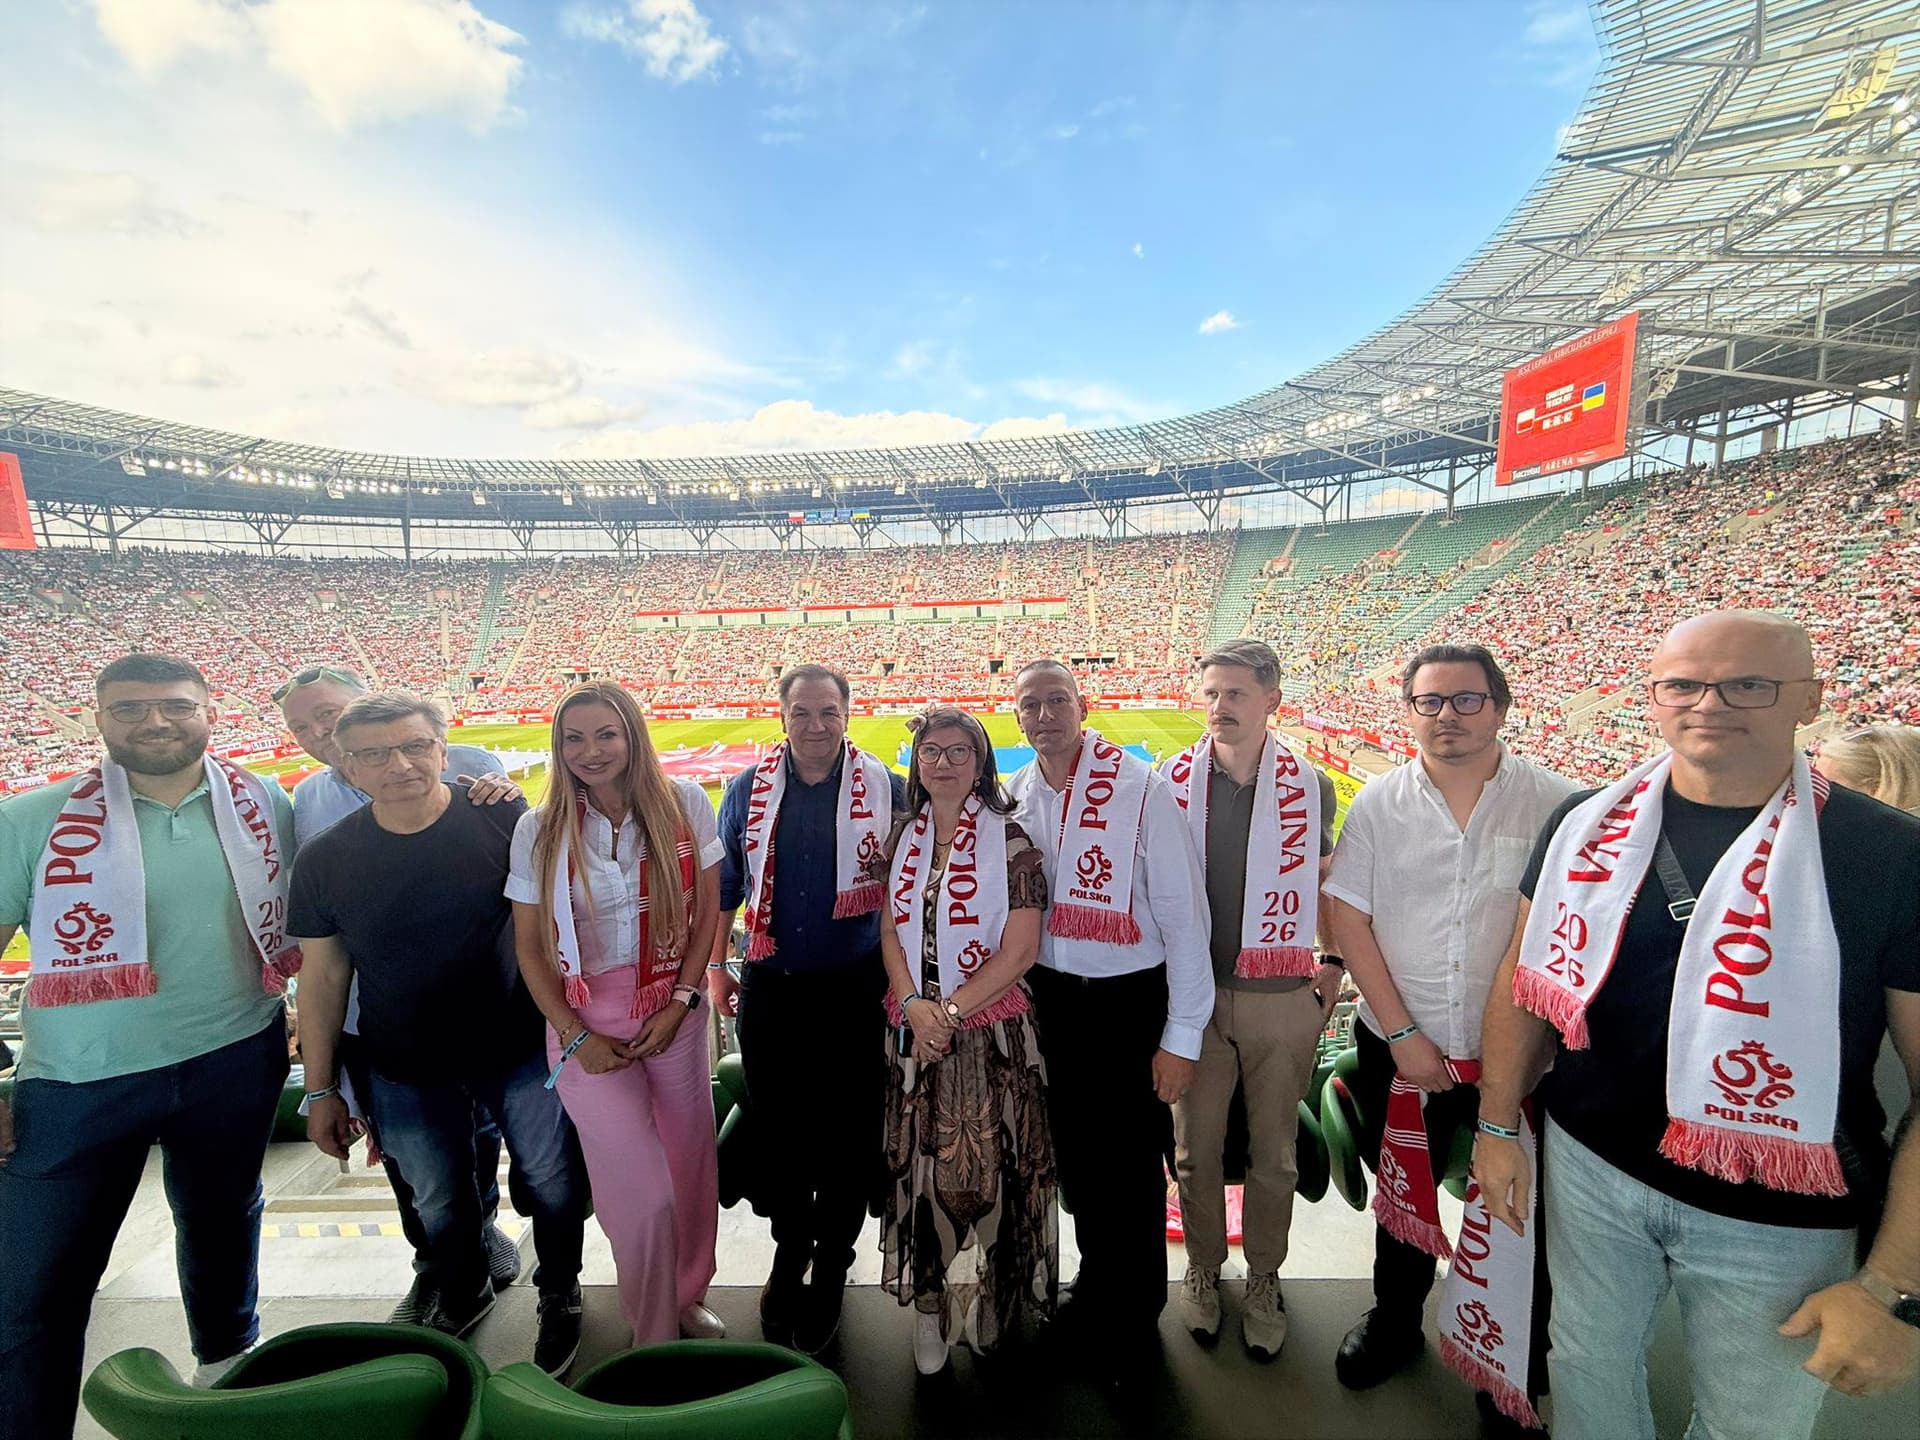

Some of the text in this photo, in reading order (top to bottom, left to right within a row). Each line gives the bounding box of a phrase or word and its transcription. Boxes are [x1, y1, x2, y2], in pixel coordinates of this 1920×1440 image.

[1545, 456, 1574, 471] ARENA
[1069, 887, 1112, 905] POLSKA
[1262, 889, 1300, 917] 20
[258, 895, 284, 928] 20
[1259, 920, 1297, 943] 26
[1552, 901, 1588, 952] 20
[51, 951, 119, 968] POLSKA
[1545, 943, 1585, 987] 26
[1704, 1103, 1799, 1132] POLSKA
[1451, 1331, 1506, 1374] POLSKA
